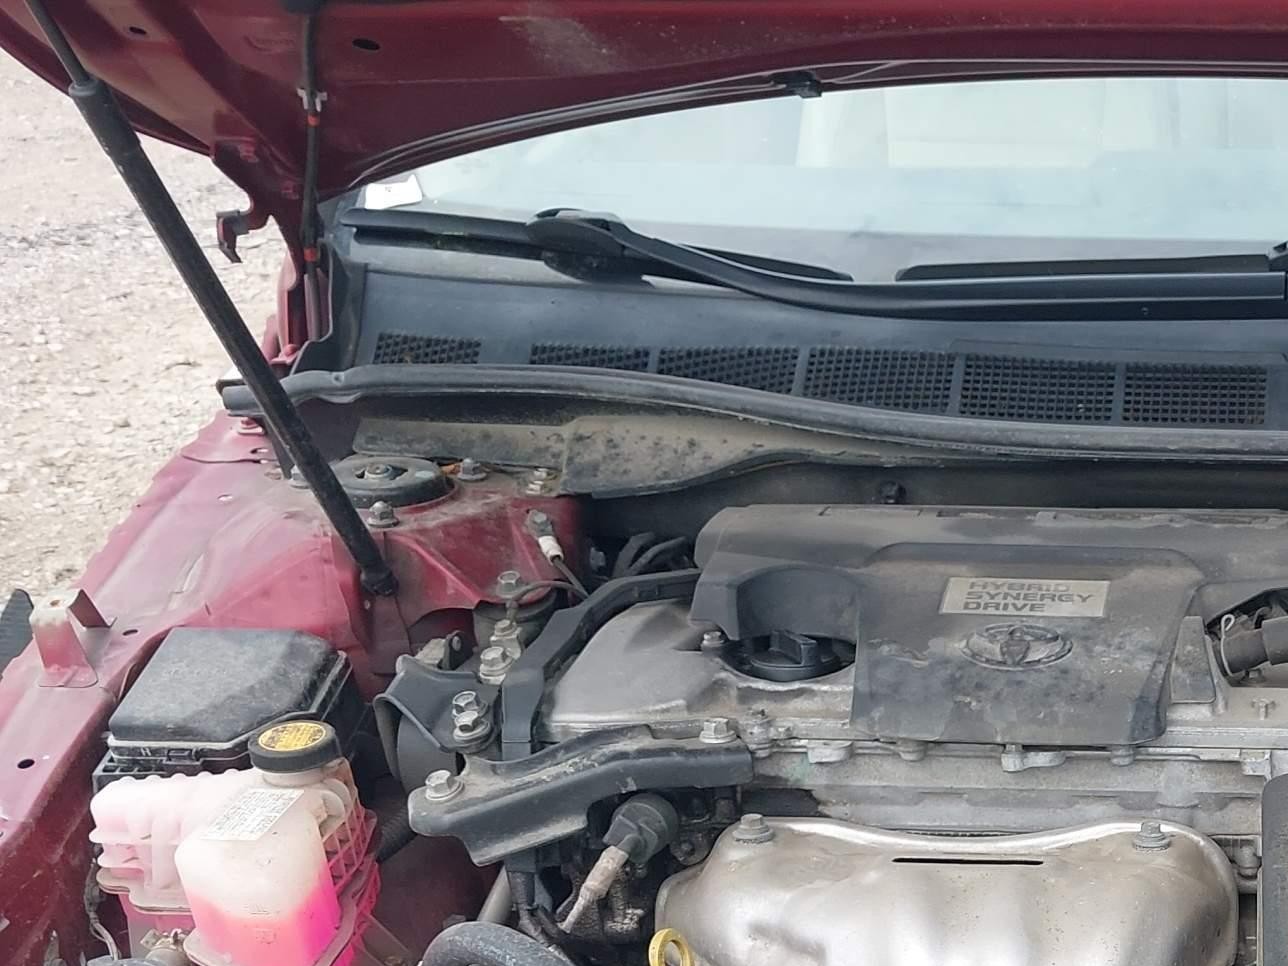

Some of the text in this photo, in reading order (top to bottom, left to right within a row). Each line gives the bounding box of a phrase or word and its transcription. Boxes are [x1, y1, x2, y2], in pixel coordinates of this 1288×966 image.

[968, 581, 1072, 592] HYBRID
[965, 591, 1094, 603] SYNERGY
[962, 601, 1047, 612] DRIVE
